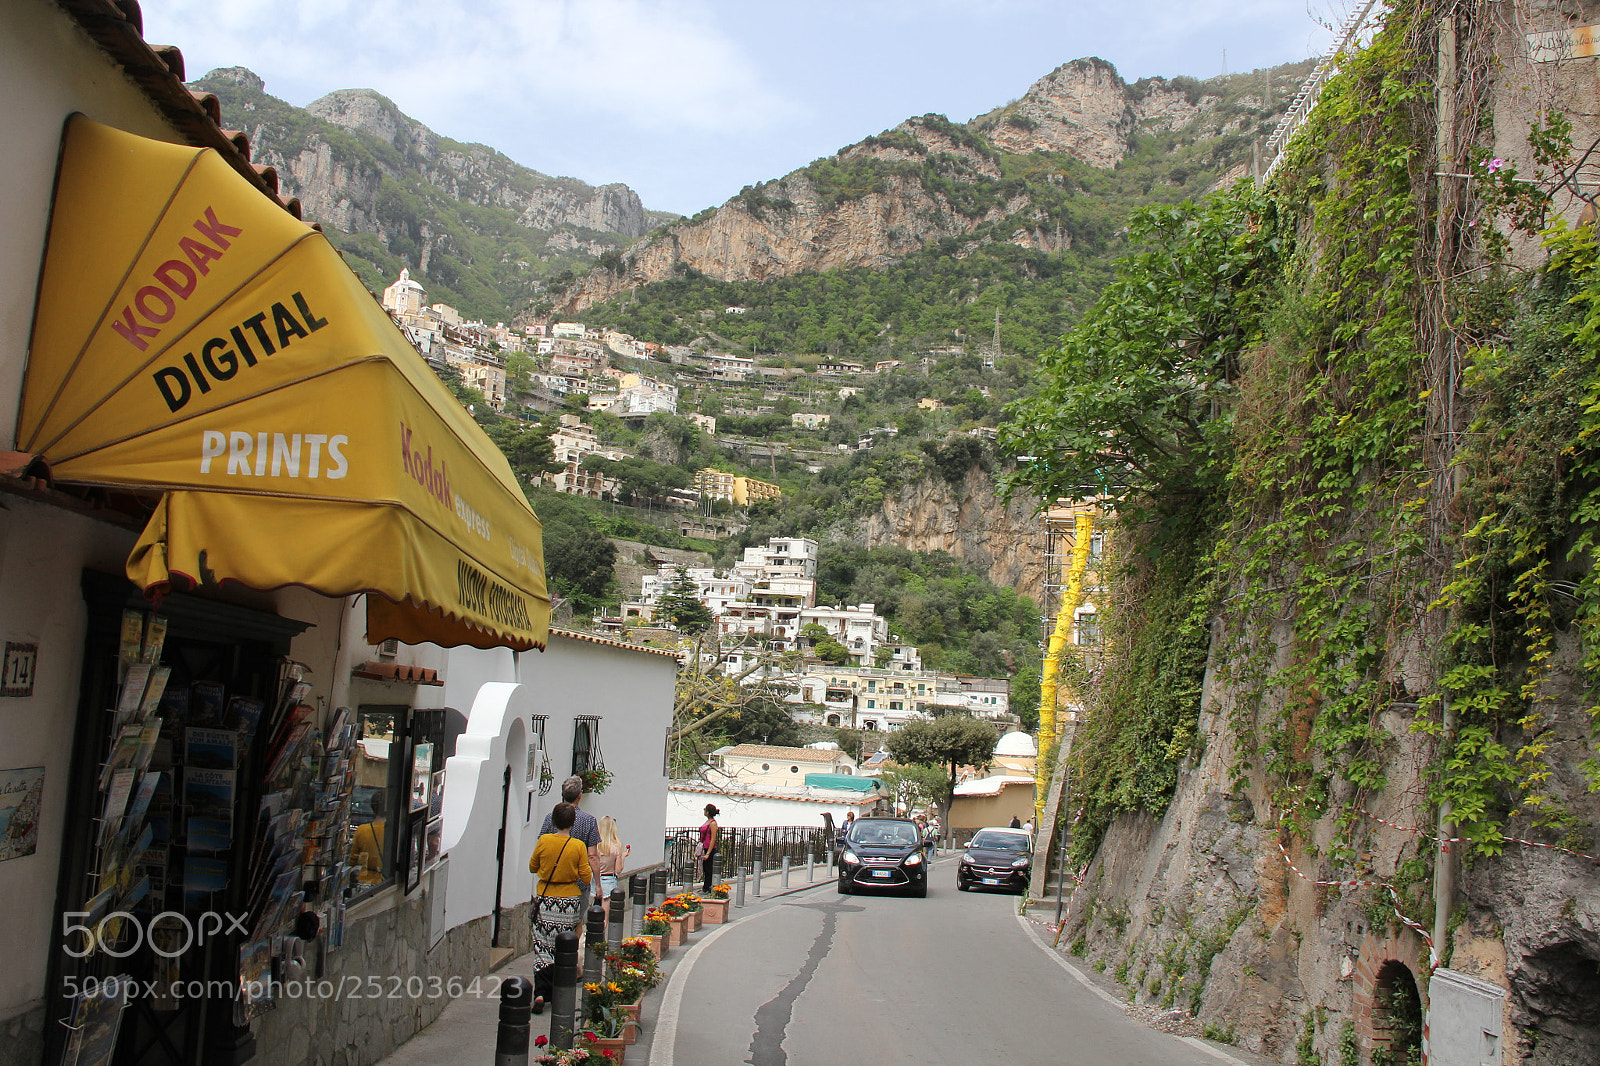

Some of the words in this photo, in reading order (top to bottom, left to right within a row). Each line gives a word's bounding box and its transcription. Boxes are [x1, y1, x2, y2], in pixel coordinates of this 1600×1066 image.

[111, 206, 243, 351] KODAK
[153, 291, 328, 413] DIGITAL
[200, 430, 350, 480] PRINTS
[401, 422, 453, 510] Kodak
[455, 496, 491, 541] express
[457, 558, 488, 617] NUOVA
[489, 580, 533, 631] FOTOGRAFIA
[13, 656, 29, 684] 14
